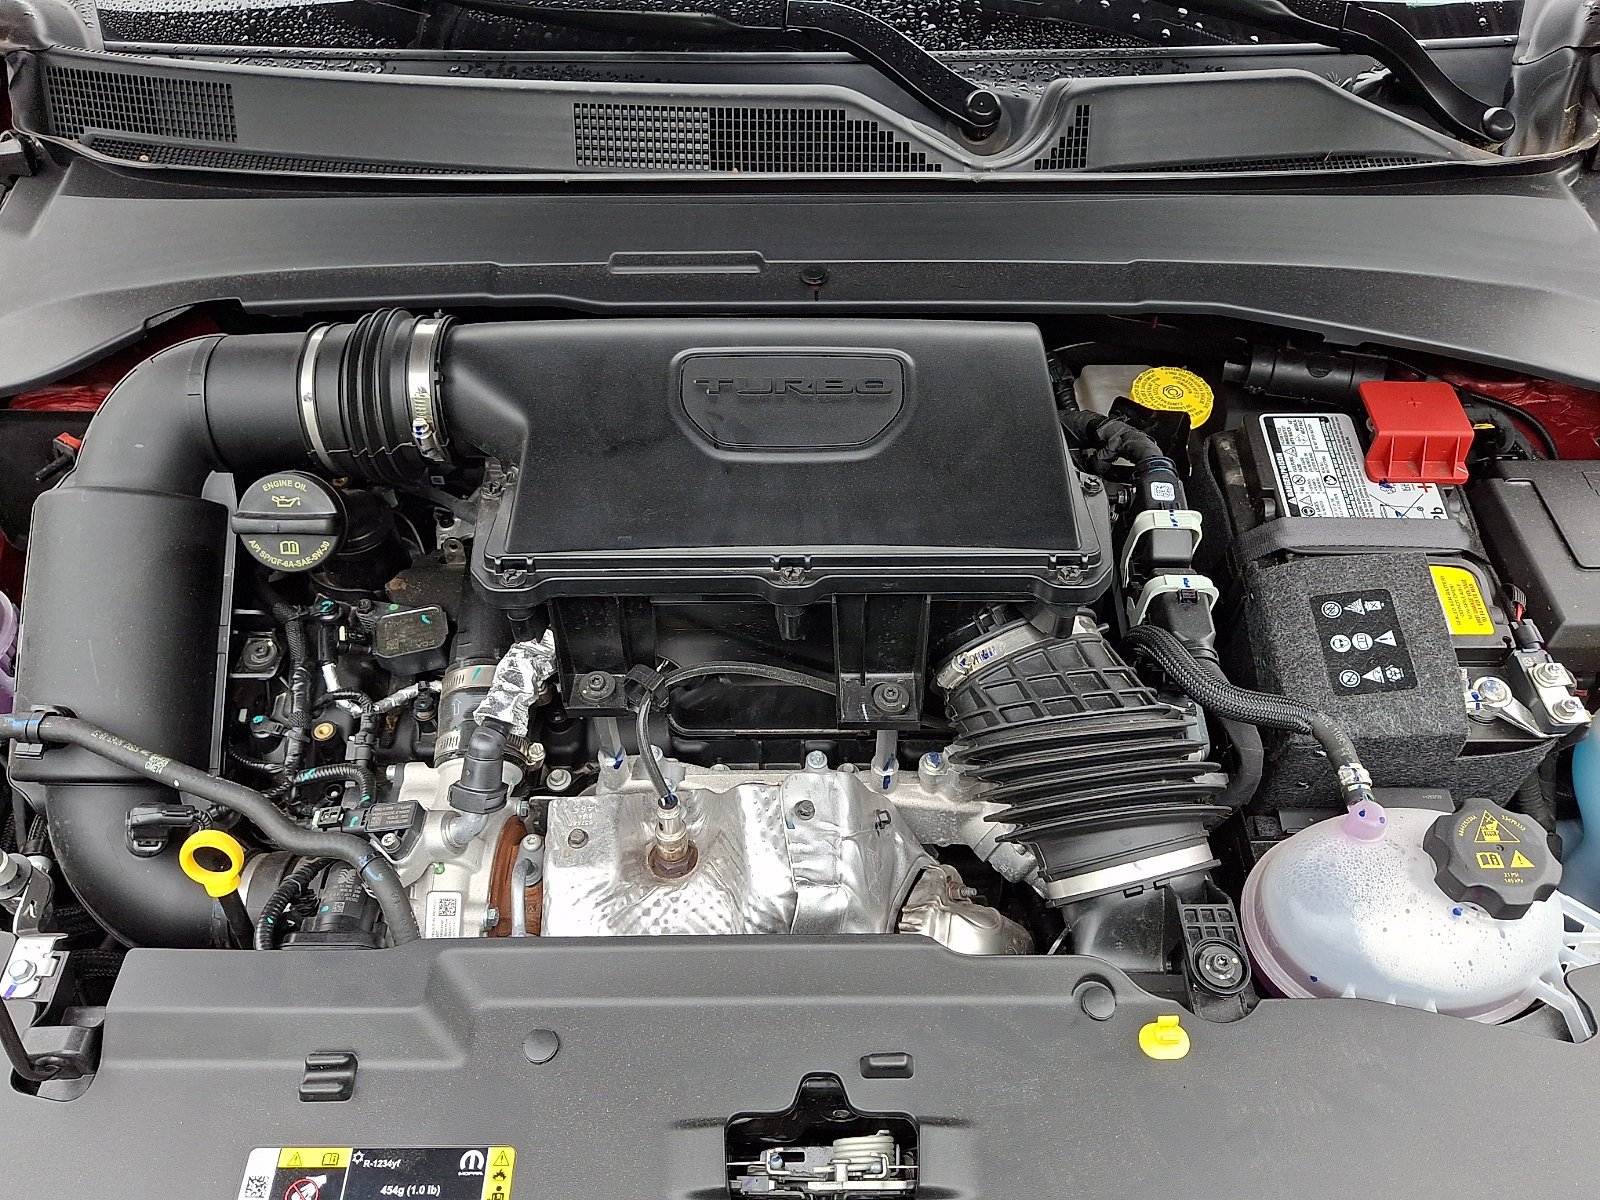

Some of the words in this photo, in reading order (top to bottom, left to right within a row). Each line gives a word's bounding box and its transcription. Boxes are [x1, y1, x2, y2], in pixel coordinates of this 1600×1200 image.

[693, 376, 893, 396] TURBO
[262, 480, 293, 492] ENGINE
[294, 480, 308, 493] OIL
[248, 540, 262, 553] API
[363, 1159, 402, 1170] R-1234yf
[380, 1184, 405, 1198] 454g
[406, 1184, 426, 1198] (1.0
